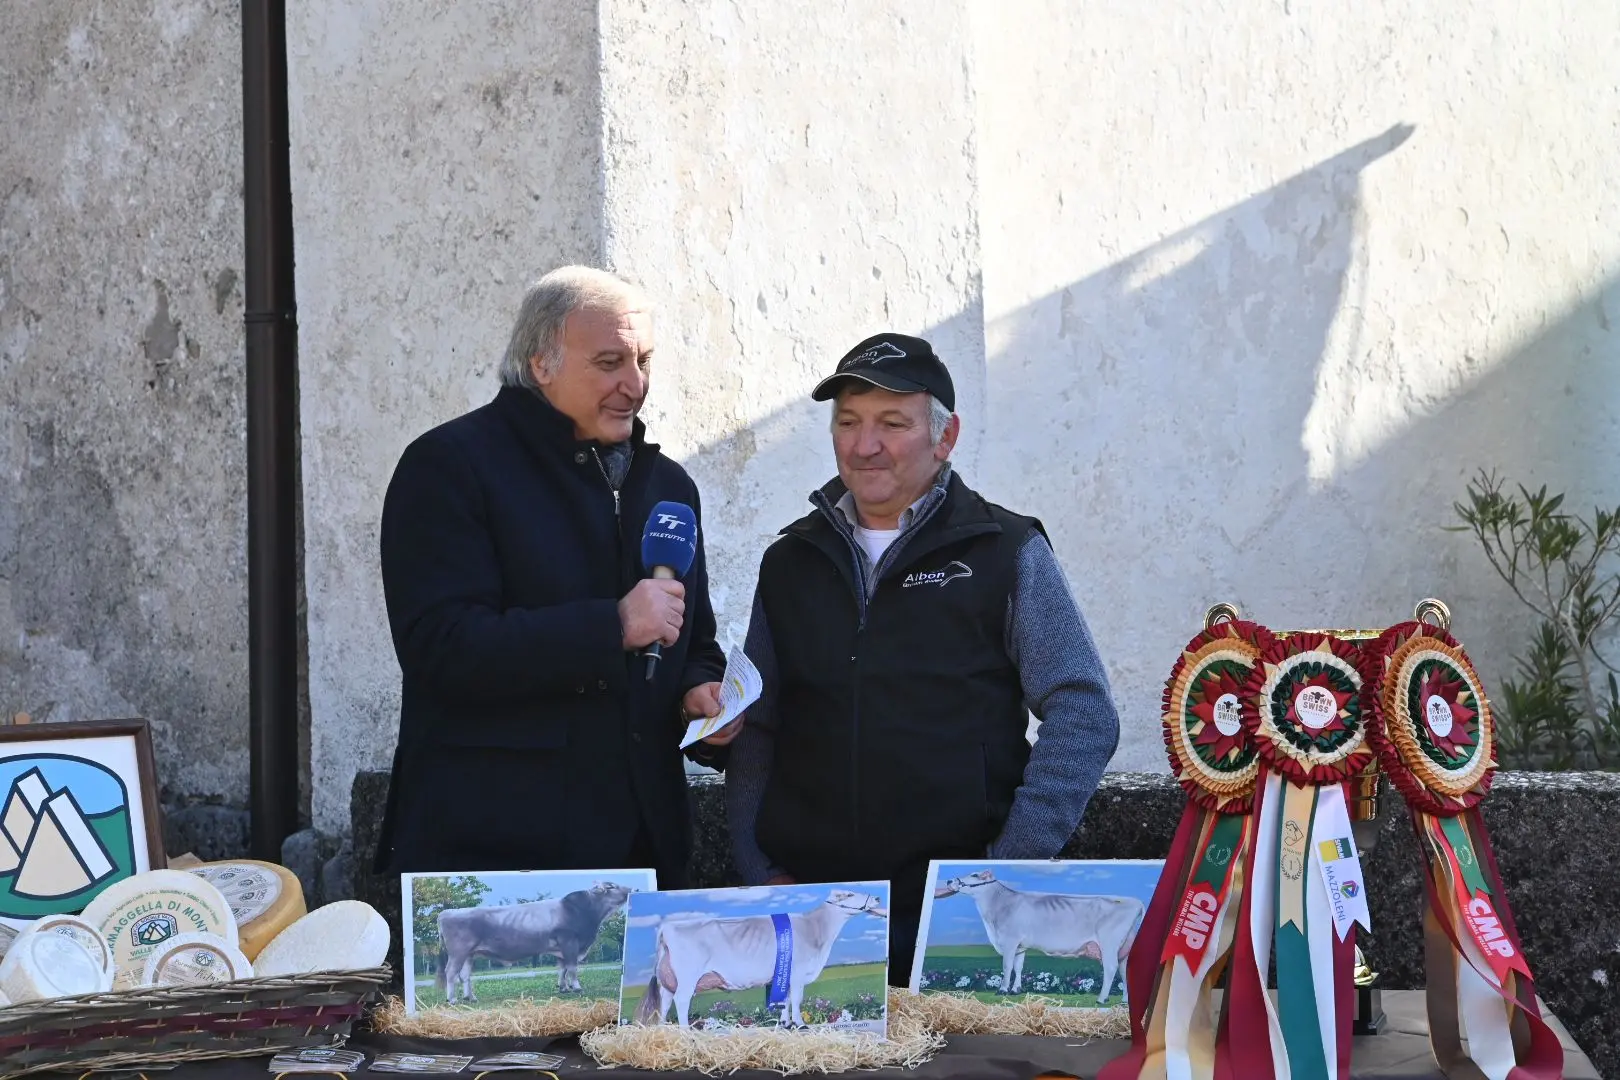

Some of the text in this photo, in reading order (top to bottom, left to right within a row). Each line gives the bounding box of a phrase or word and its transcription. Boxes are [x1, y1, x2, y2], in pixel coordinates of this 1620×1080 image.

[649, 531, 686, 542] TELETUTTO
[904, 571, 945, 583] Albon
[1217, 711, 1238, 722] SWISS
[1303, 701, 1329, 713] SWISS
[1325, 865, 1347, 921] MAZZOLENI
[167, 900, 182, 912] DI
[182, 906, 209, 933] MONT
[1180, 891, 1218, 950] CMP
[1468, 897, 1515, 958] CMP
